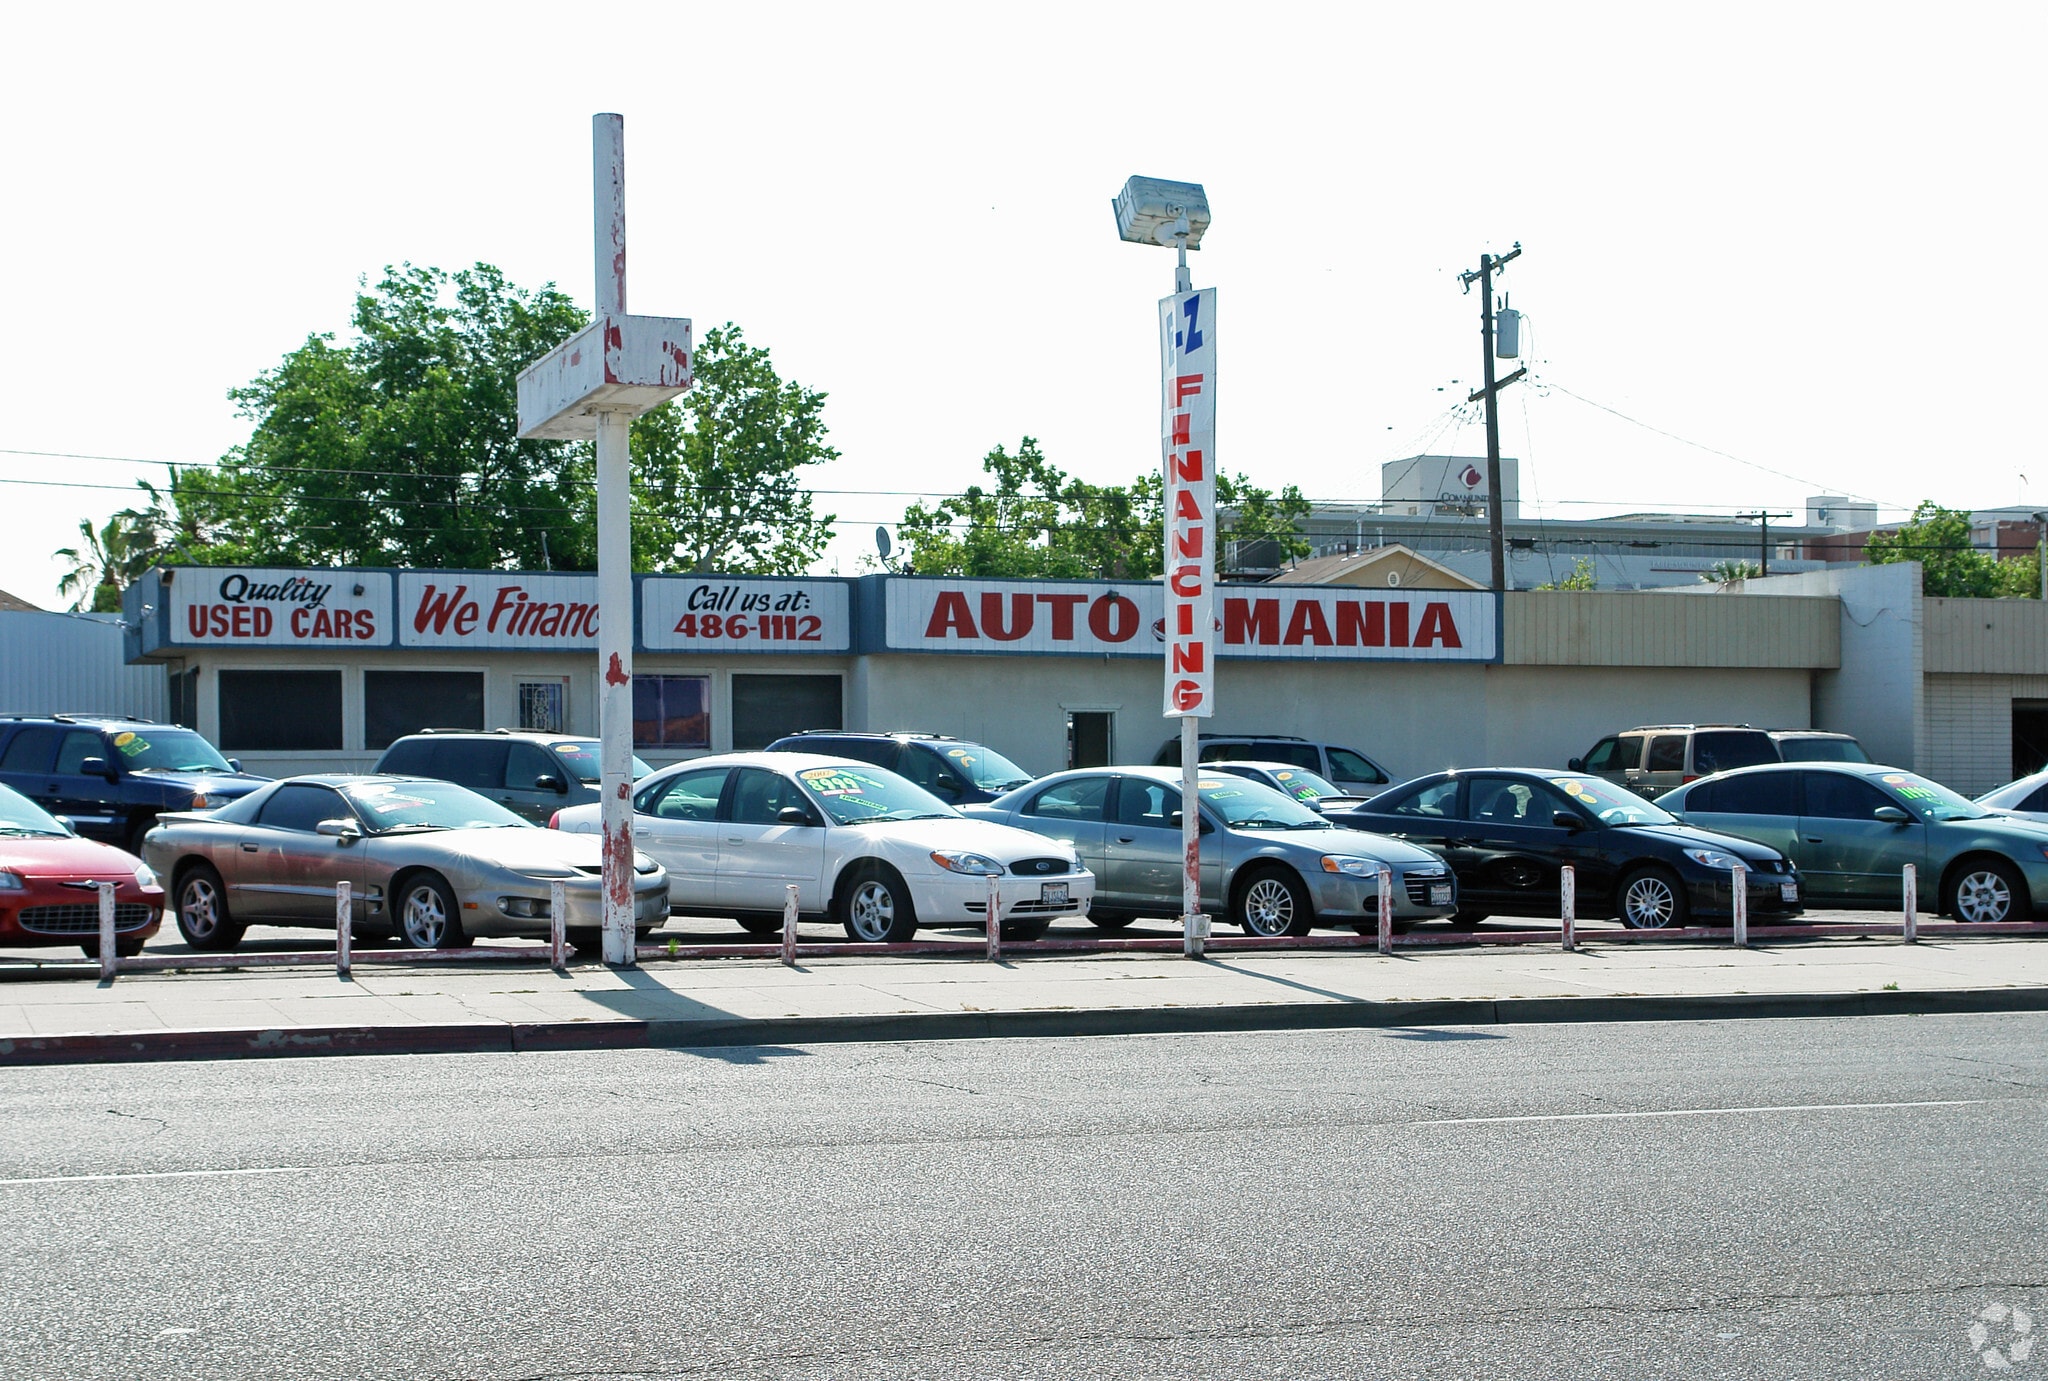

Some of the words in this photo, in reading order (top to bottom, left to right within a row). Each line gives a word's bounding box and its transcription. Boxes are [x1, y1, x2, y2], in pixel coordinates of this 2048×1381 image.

[1168, 373, 1204, 712] FINANCING
[219, 574, 332, 609] Quality
[688, 585, 739, 612] Call
[741, 593, 770, 612] us
[774, 590, 810, 611] at:
[188, 604, 273, 638] USED
[290, 608, 375, 640] CARS
[414, 584, 479, 636] We
[487, 586, 599, 638] Financ
[673, 614, 821, 641] 486-1112
[924, 591, 1139, 643] AUTO
[1223, 598, 1463, 648] MANIA
[806, 777, 860, 792] 8999
